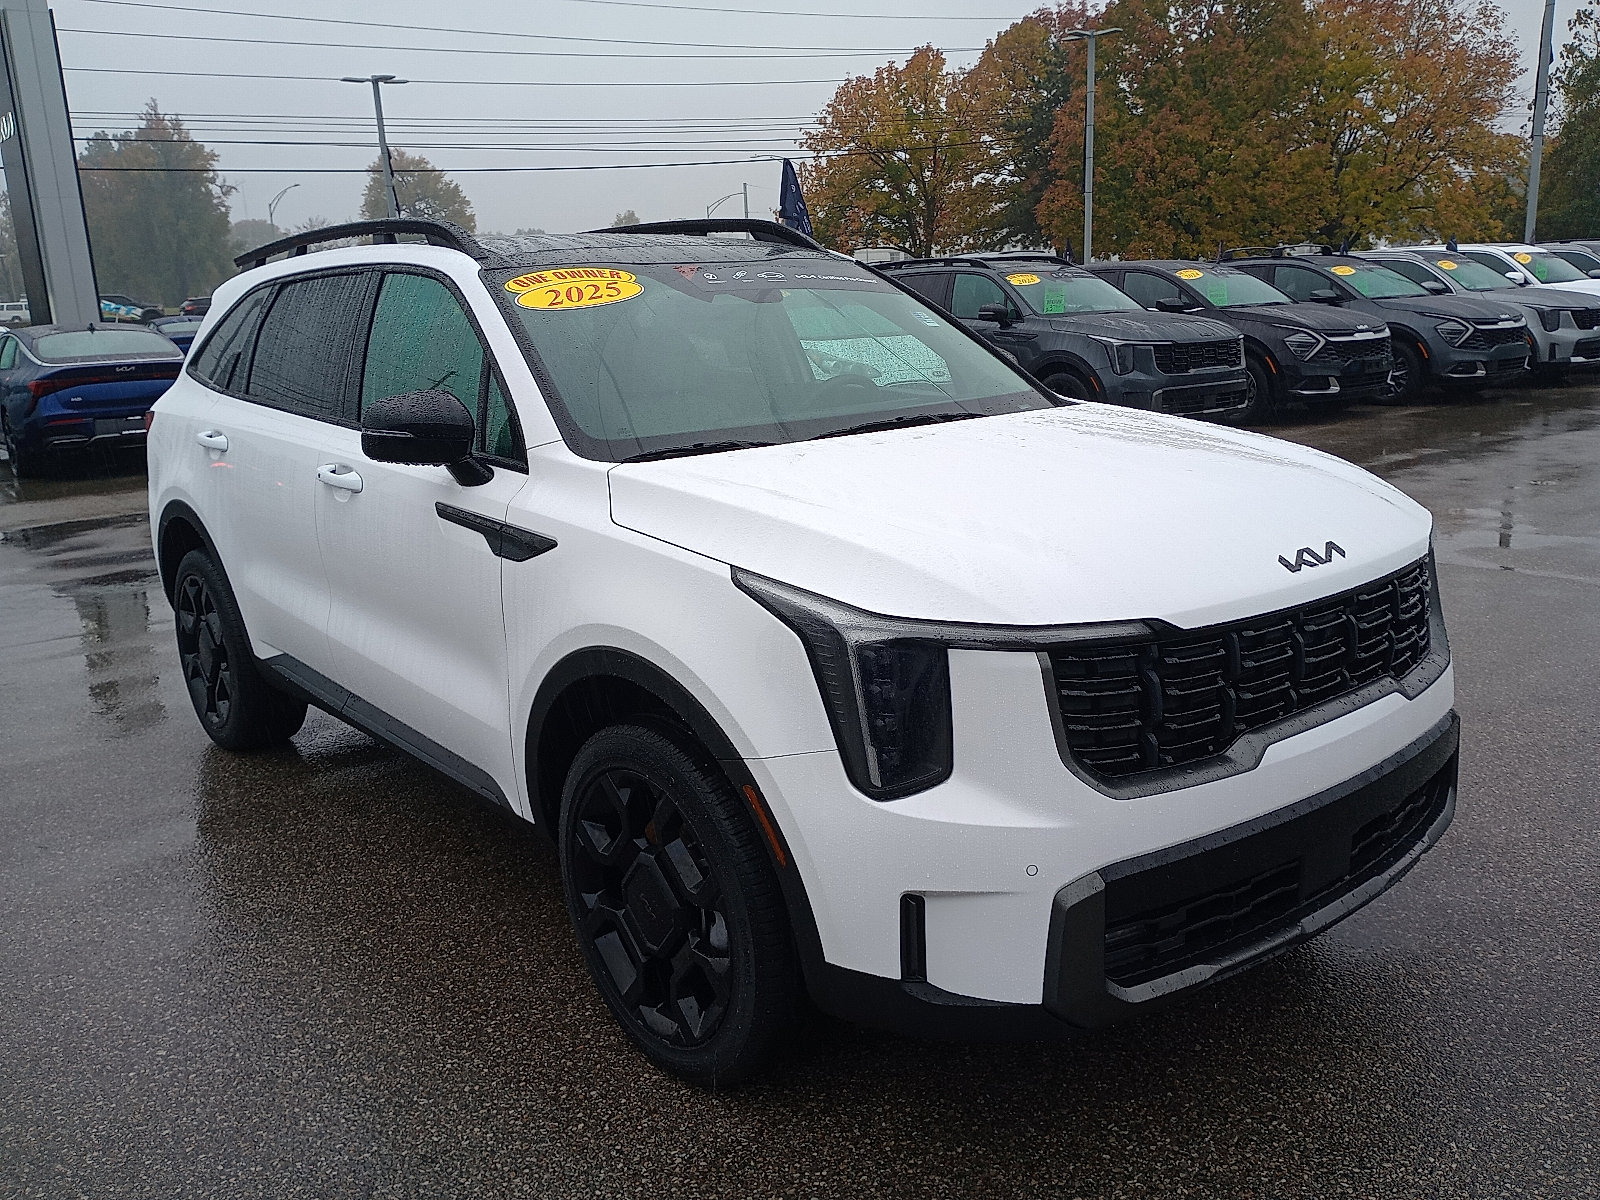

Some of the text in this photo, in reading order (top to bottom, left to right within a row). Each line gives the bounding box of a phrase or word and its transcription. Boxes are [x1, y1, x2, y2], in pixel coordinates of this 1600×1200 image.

[513, 269, 622, 288] ONE OWNER
[545, 281, 622, 307] 2025
[1277, 540, 1346, 574] KIA
